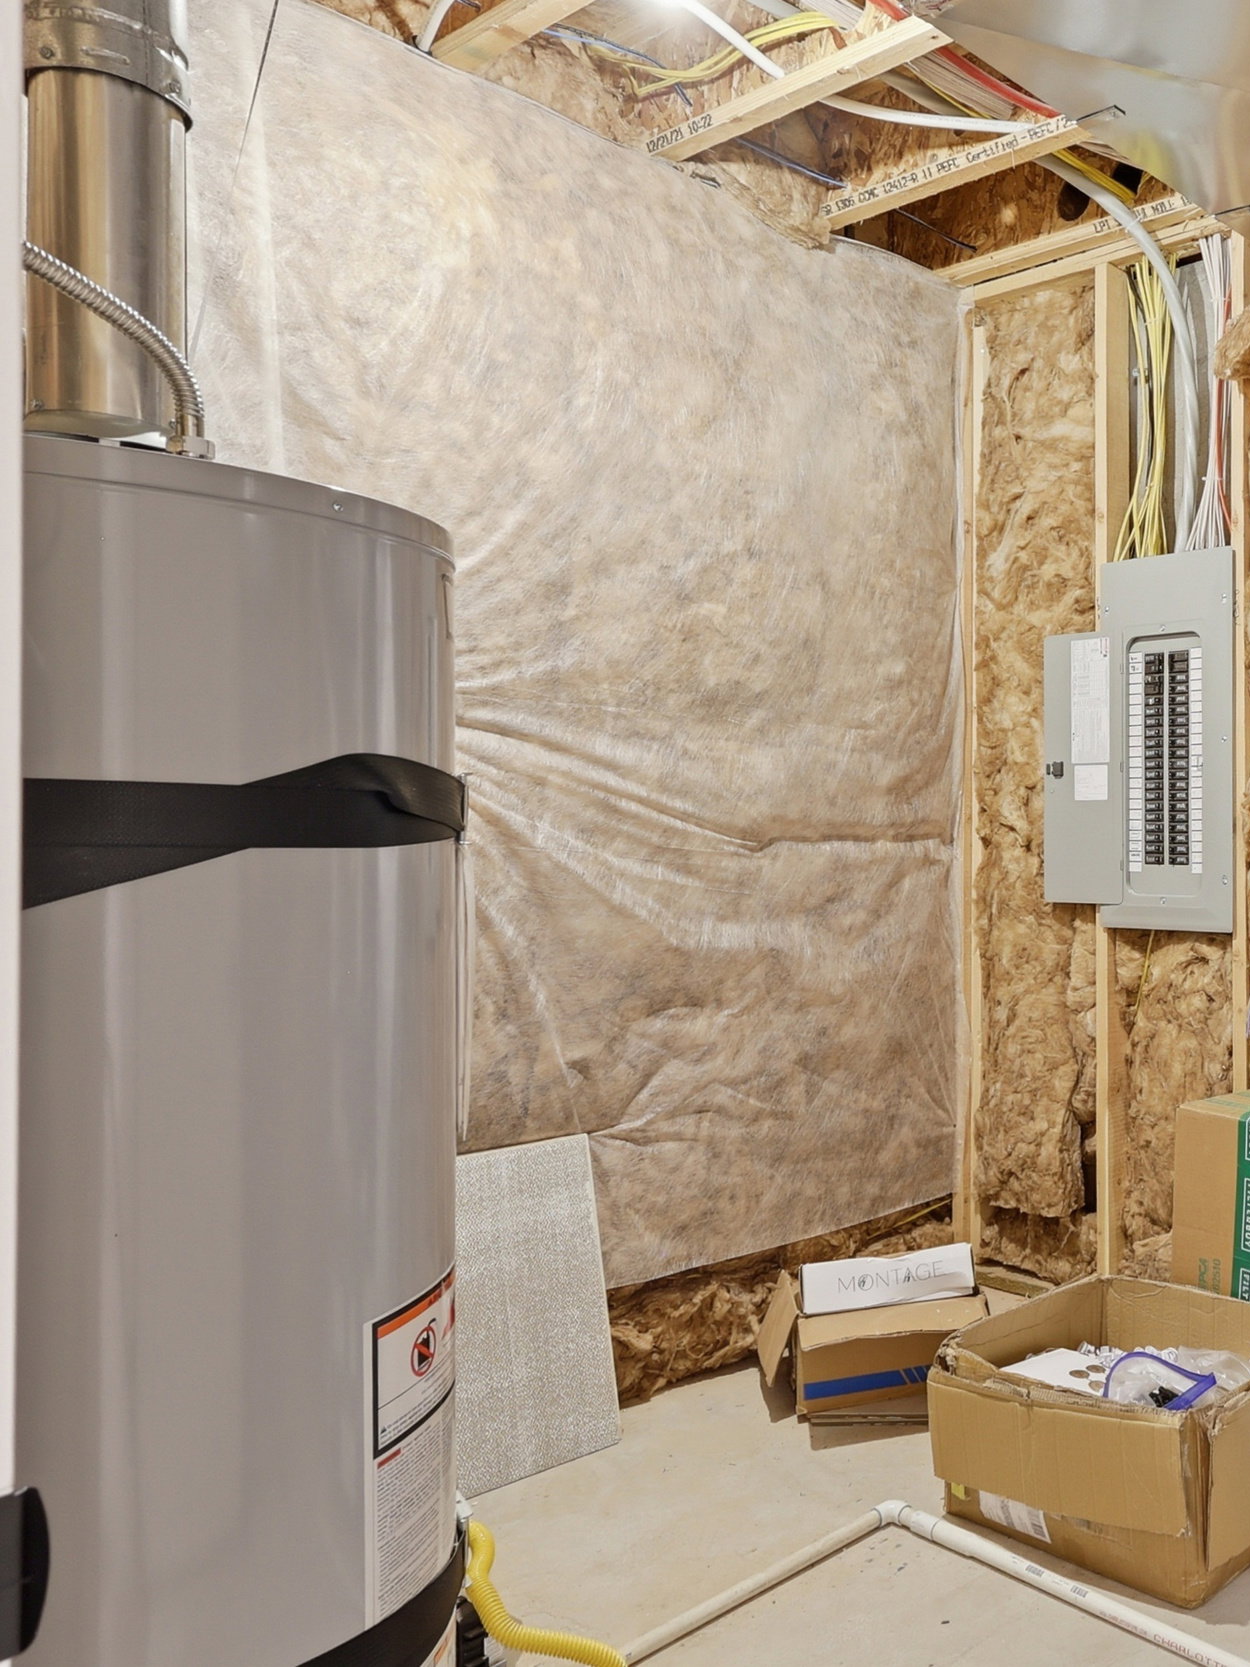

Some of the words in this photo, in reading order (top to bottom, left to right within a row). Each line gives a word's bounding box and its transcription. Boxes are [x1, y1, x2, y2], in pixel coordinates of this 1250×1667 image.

[646, 127, 684, 153] 12/21/21
[966, 134, 1020, 164] Certified
[837, 1260, 945, 1293] MONTAGE
